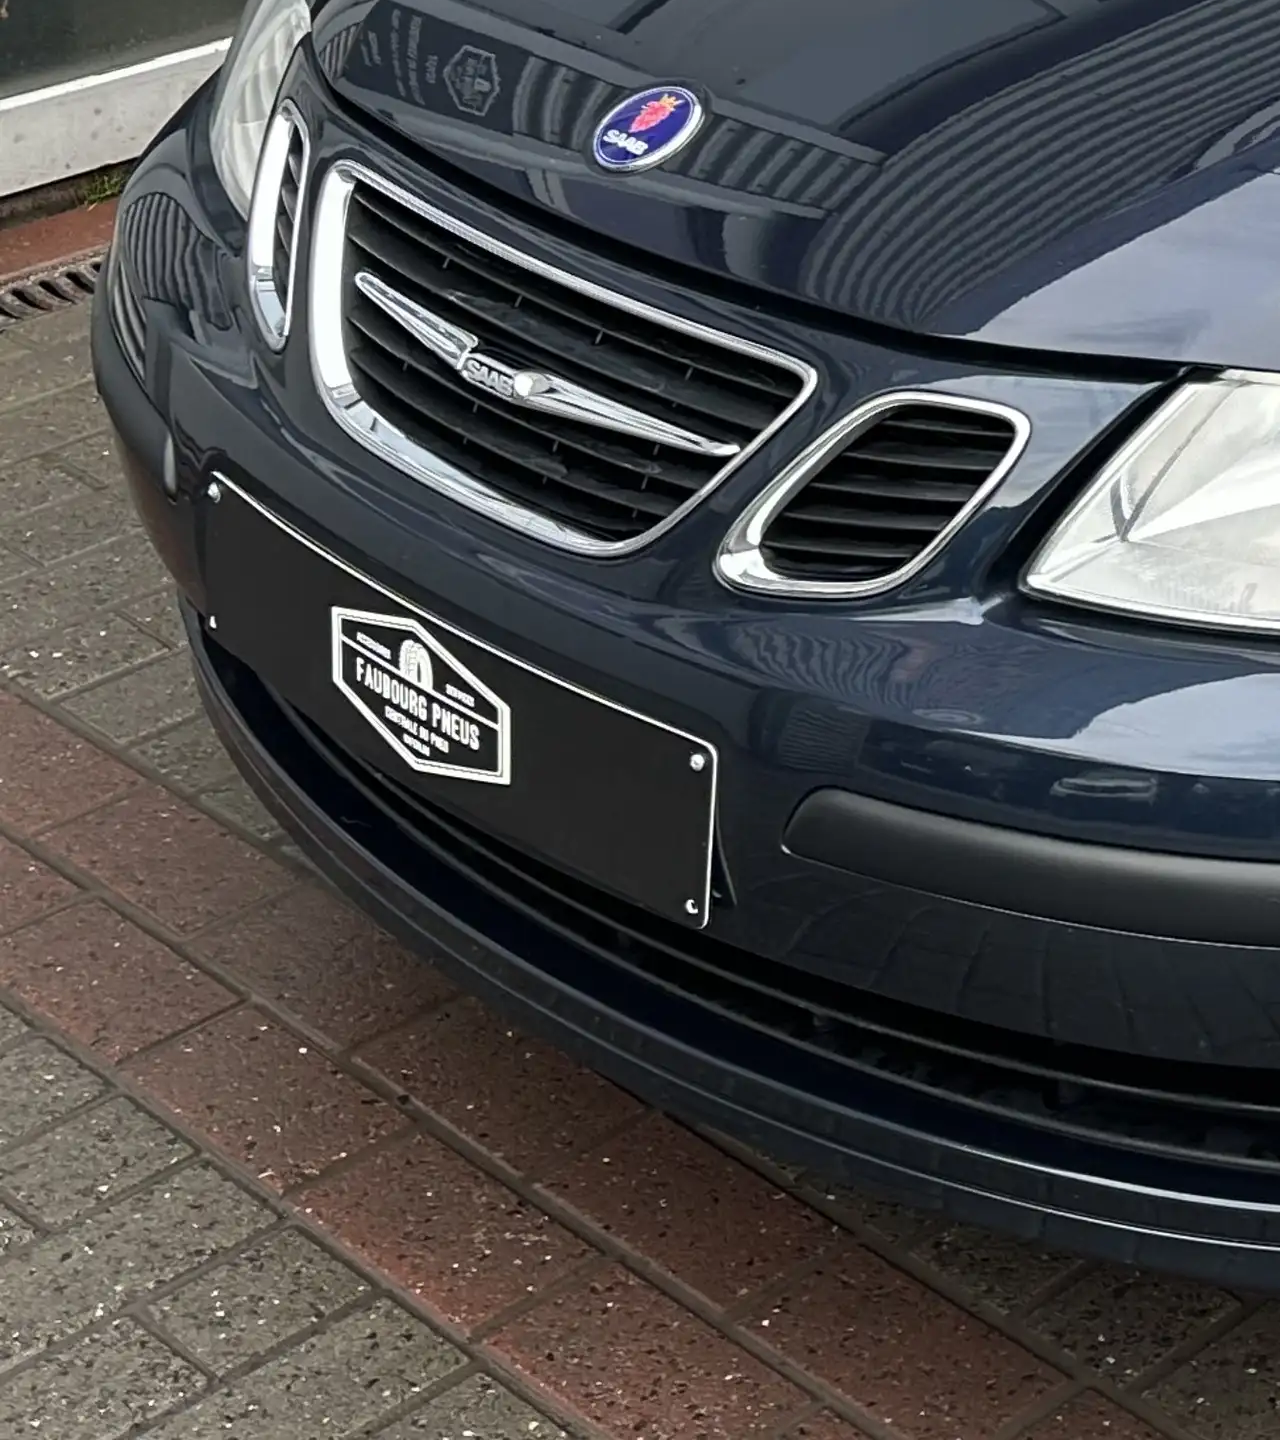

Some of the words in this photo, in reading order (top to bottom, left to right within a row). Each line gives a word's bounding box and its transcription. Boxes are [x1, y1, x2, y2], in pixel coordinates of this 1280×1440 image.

[603, 129, 649, 155] SAAB
[466, 359, 513, 396] SAAB
[356, 656, 427, 721] FAUBOURG
[432, 702, 480, 751] PNEUS
